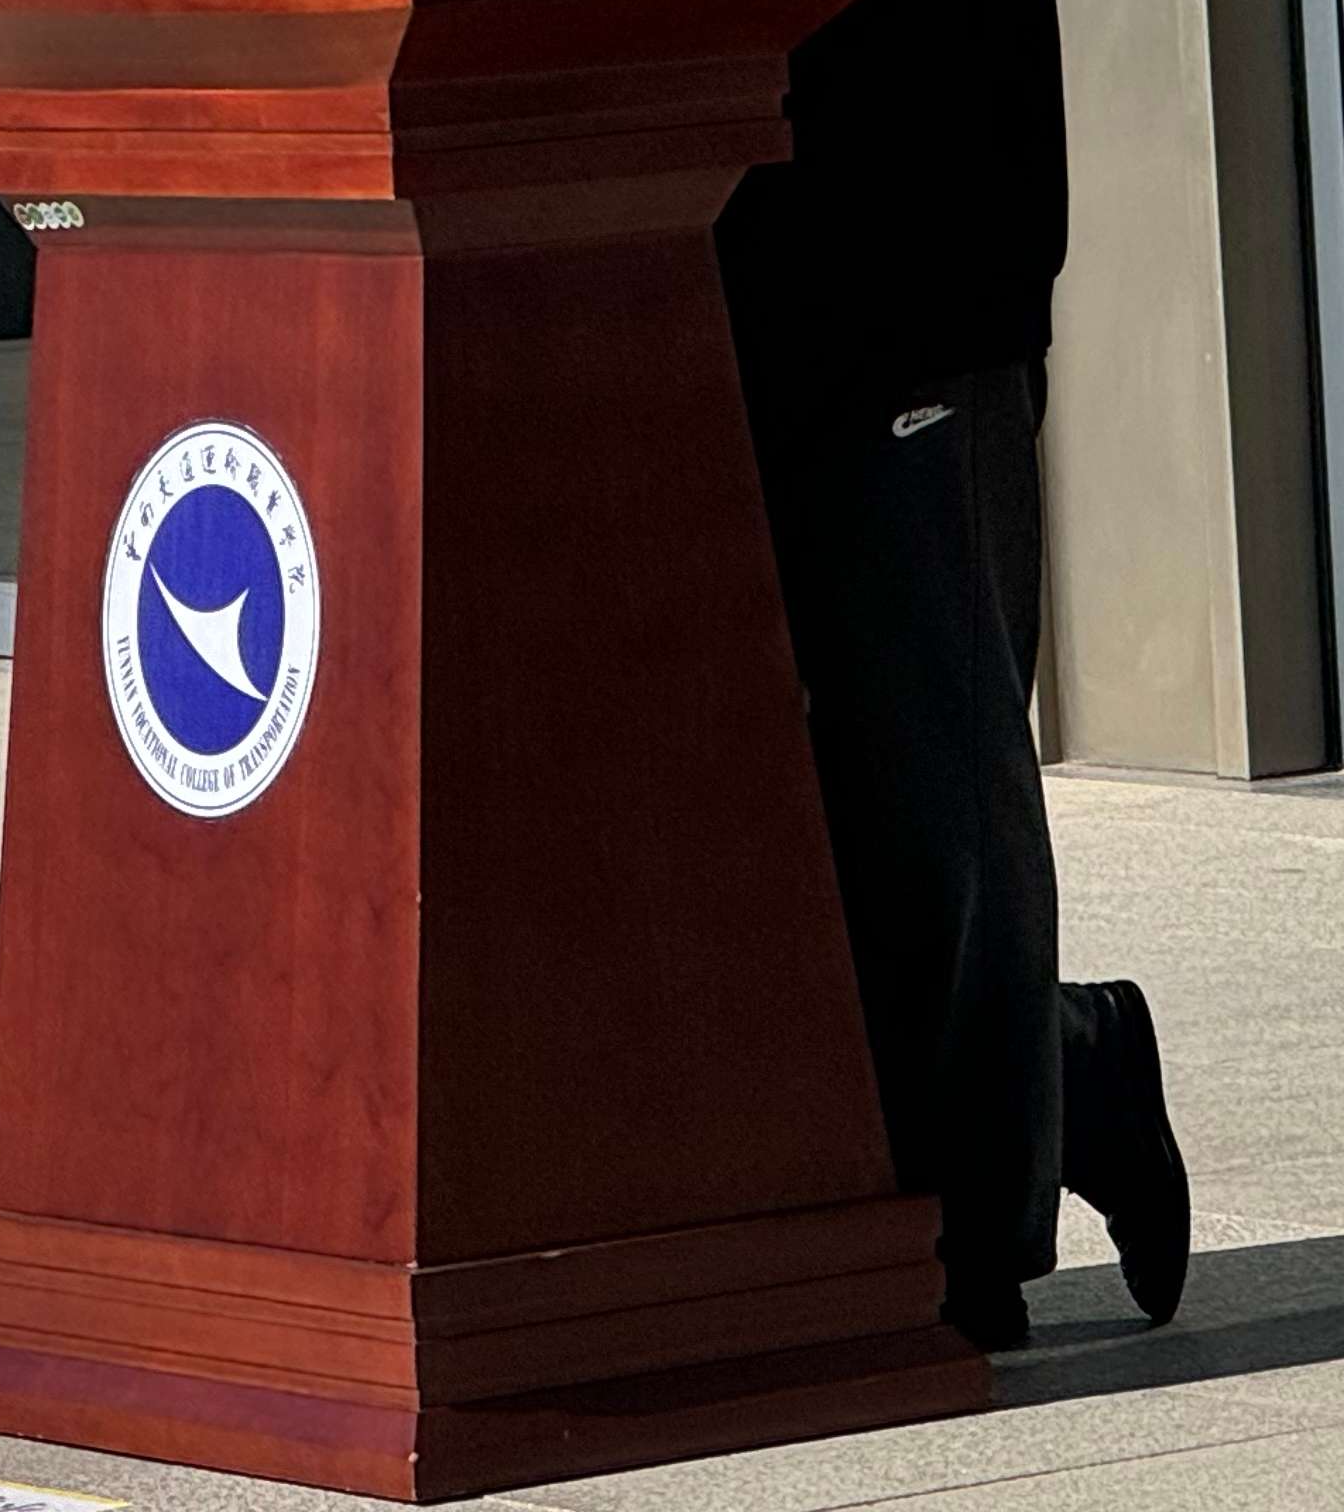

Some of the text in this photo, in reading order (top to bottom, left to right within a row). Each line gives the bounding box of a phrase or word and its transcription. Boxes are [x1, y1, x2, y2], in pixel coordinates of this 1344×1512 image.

[117, 635, 301, 792] YUNNAN VOCATIONAL COLLEGE OF TRANSPORTATION
